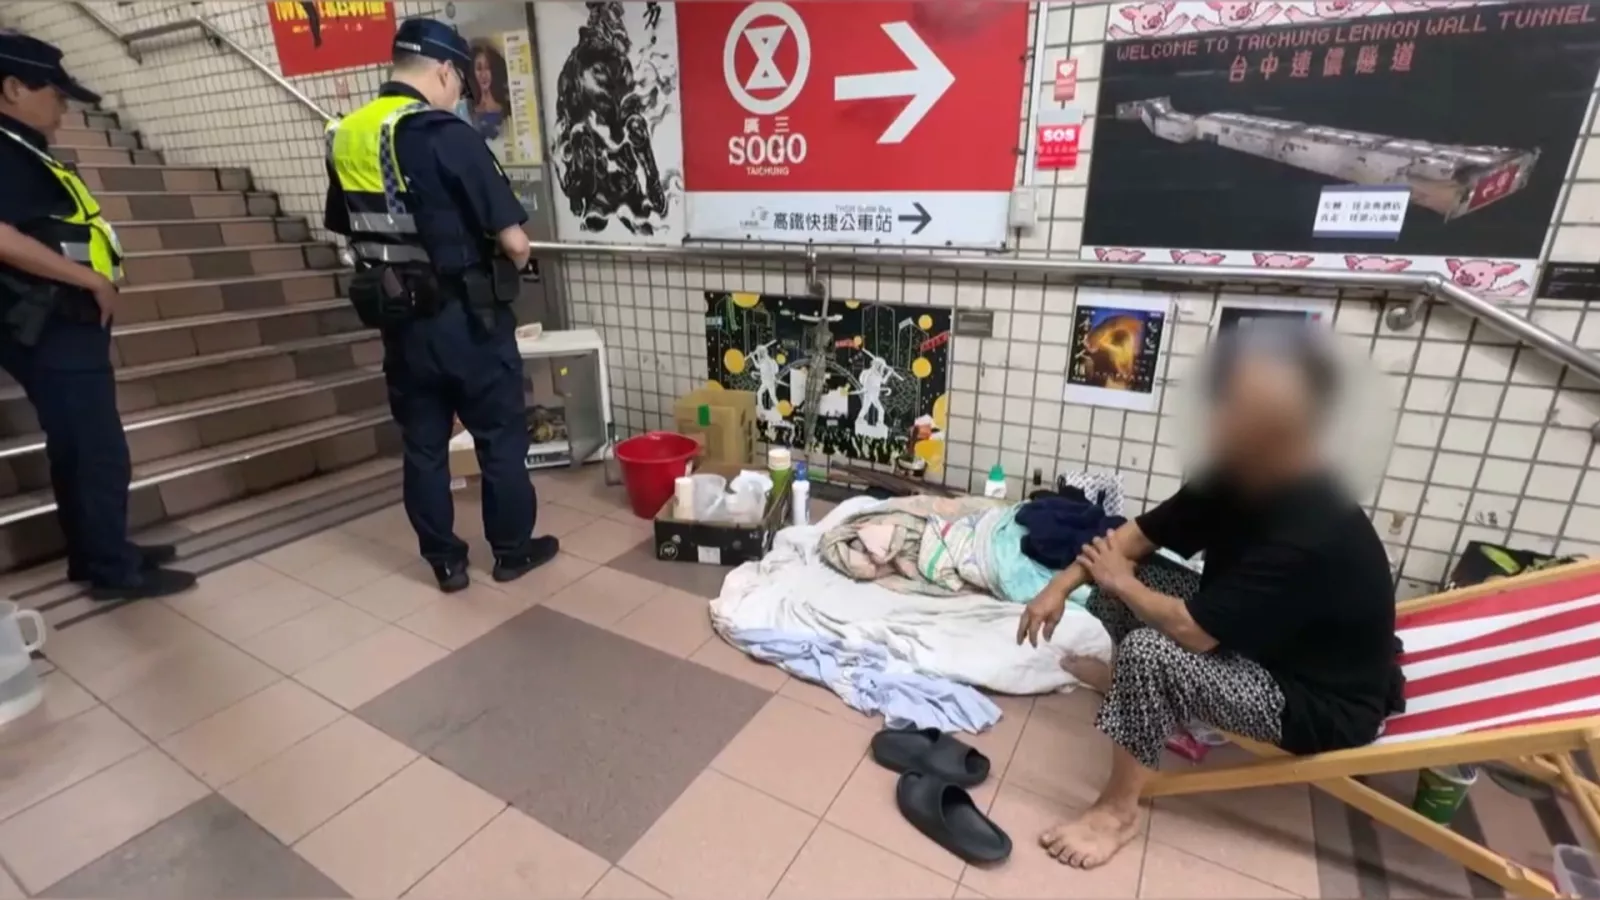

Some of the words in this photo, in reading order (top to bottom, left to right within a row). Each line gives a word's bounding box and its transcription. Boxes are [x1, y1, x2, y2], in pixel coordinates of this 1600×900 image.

[1116, 40, 1199, 61] WELCOME
[1205, 37, 1229, 52] TO
[1236, 27, 1330, 50] TAICHUNG
[1335, 20, 1420, 44] LENNON
[1425, 14, 1487, 35] WALL
[1498, 4, 1596, 30] TUNNEL
[1043, 128, 1076, 142] SOS
[728, 132, 807, 165] SOGO
[746, 166, 790, 176] TAICHUNG
[773, 211, 893, 233] 高鐵快捷公車站
